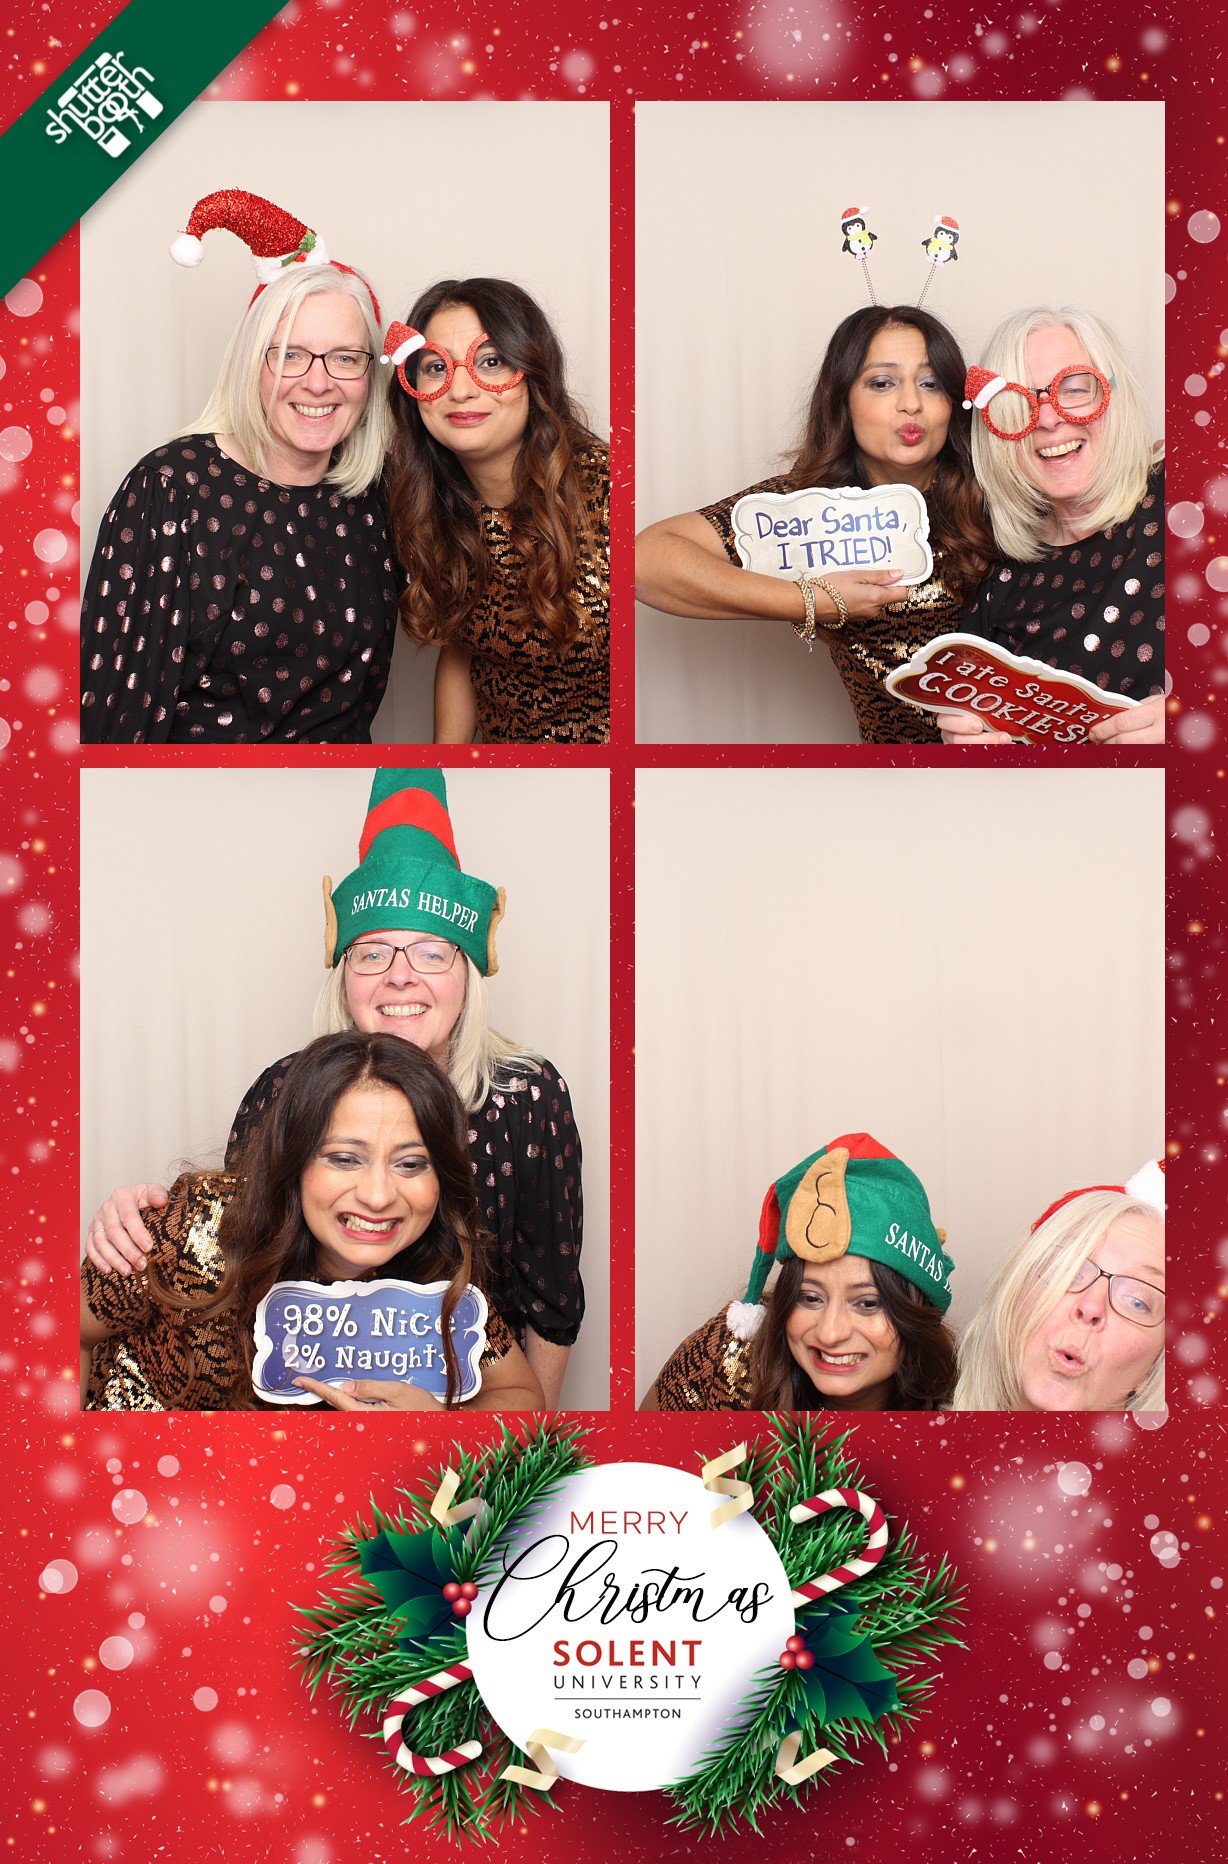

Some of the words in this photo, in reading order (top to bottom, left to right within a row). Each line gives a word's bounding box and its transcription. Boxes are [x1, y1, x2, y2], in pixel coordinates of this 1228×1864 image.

[755, 511, 814, 539] Dear
[821, 506, 907, 534] Santa,
[776, 542, 793, 570] I
[800, 536, 892, 568] TRIED!
[935, 651, 955, 666] I
[956, 661, 1009, 687] ate
[1015, 682, 1111, 724] Santa'
[351, 888, 411, 915] SANTAS
[417, 892, 479, 933] HELPER
[884, 1222, 944, 1282] SANTAS
[282, 1303, 358, 1338] 98%
[370, 1307, 456, 1337] Nice
[284, 1343, 326, 1369] 2%
